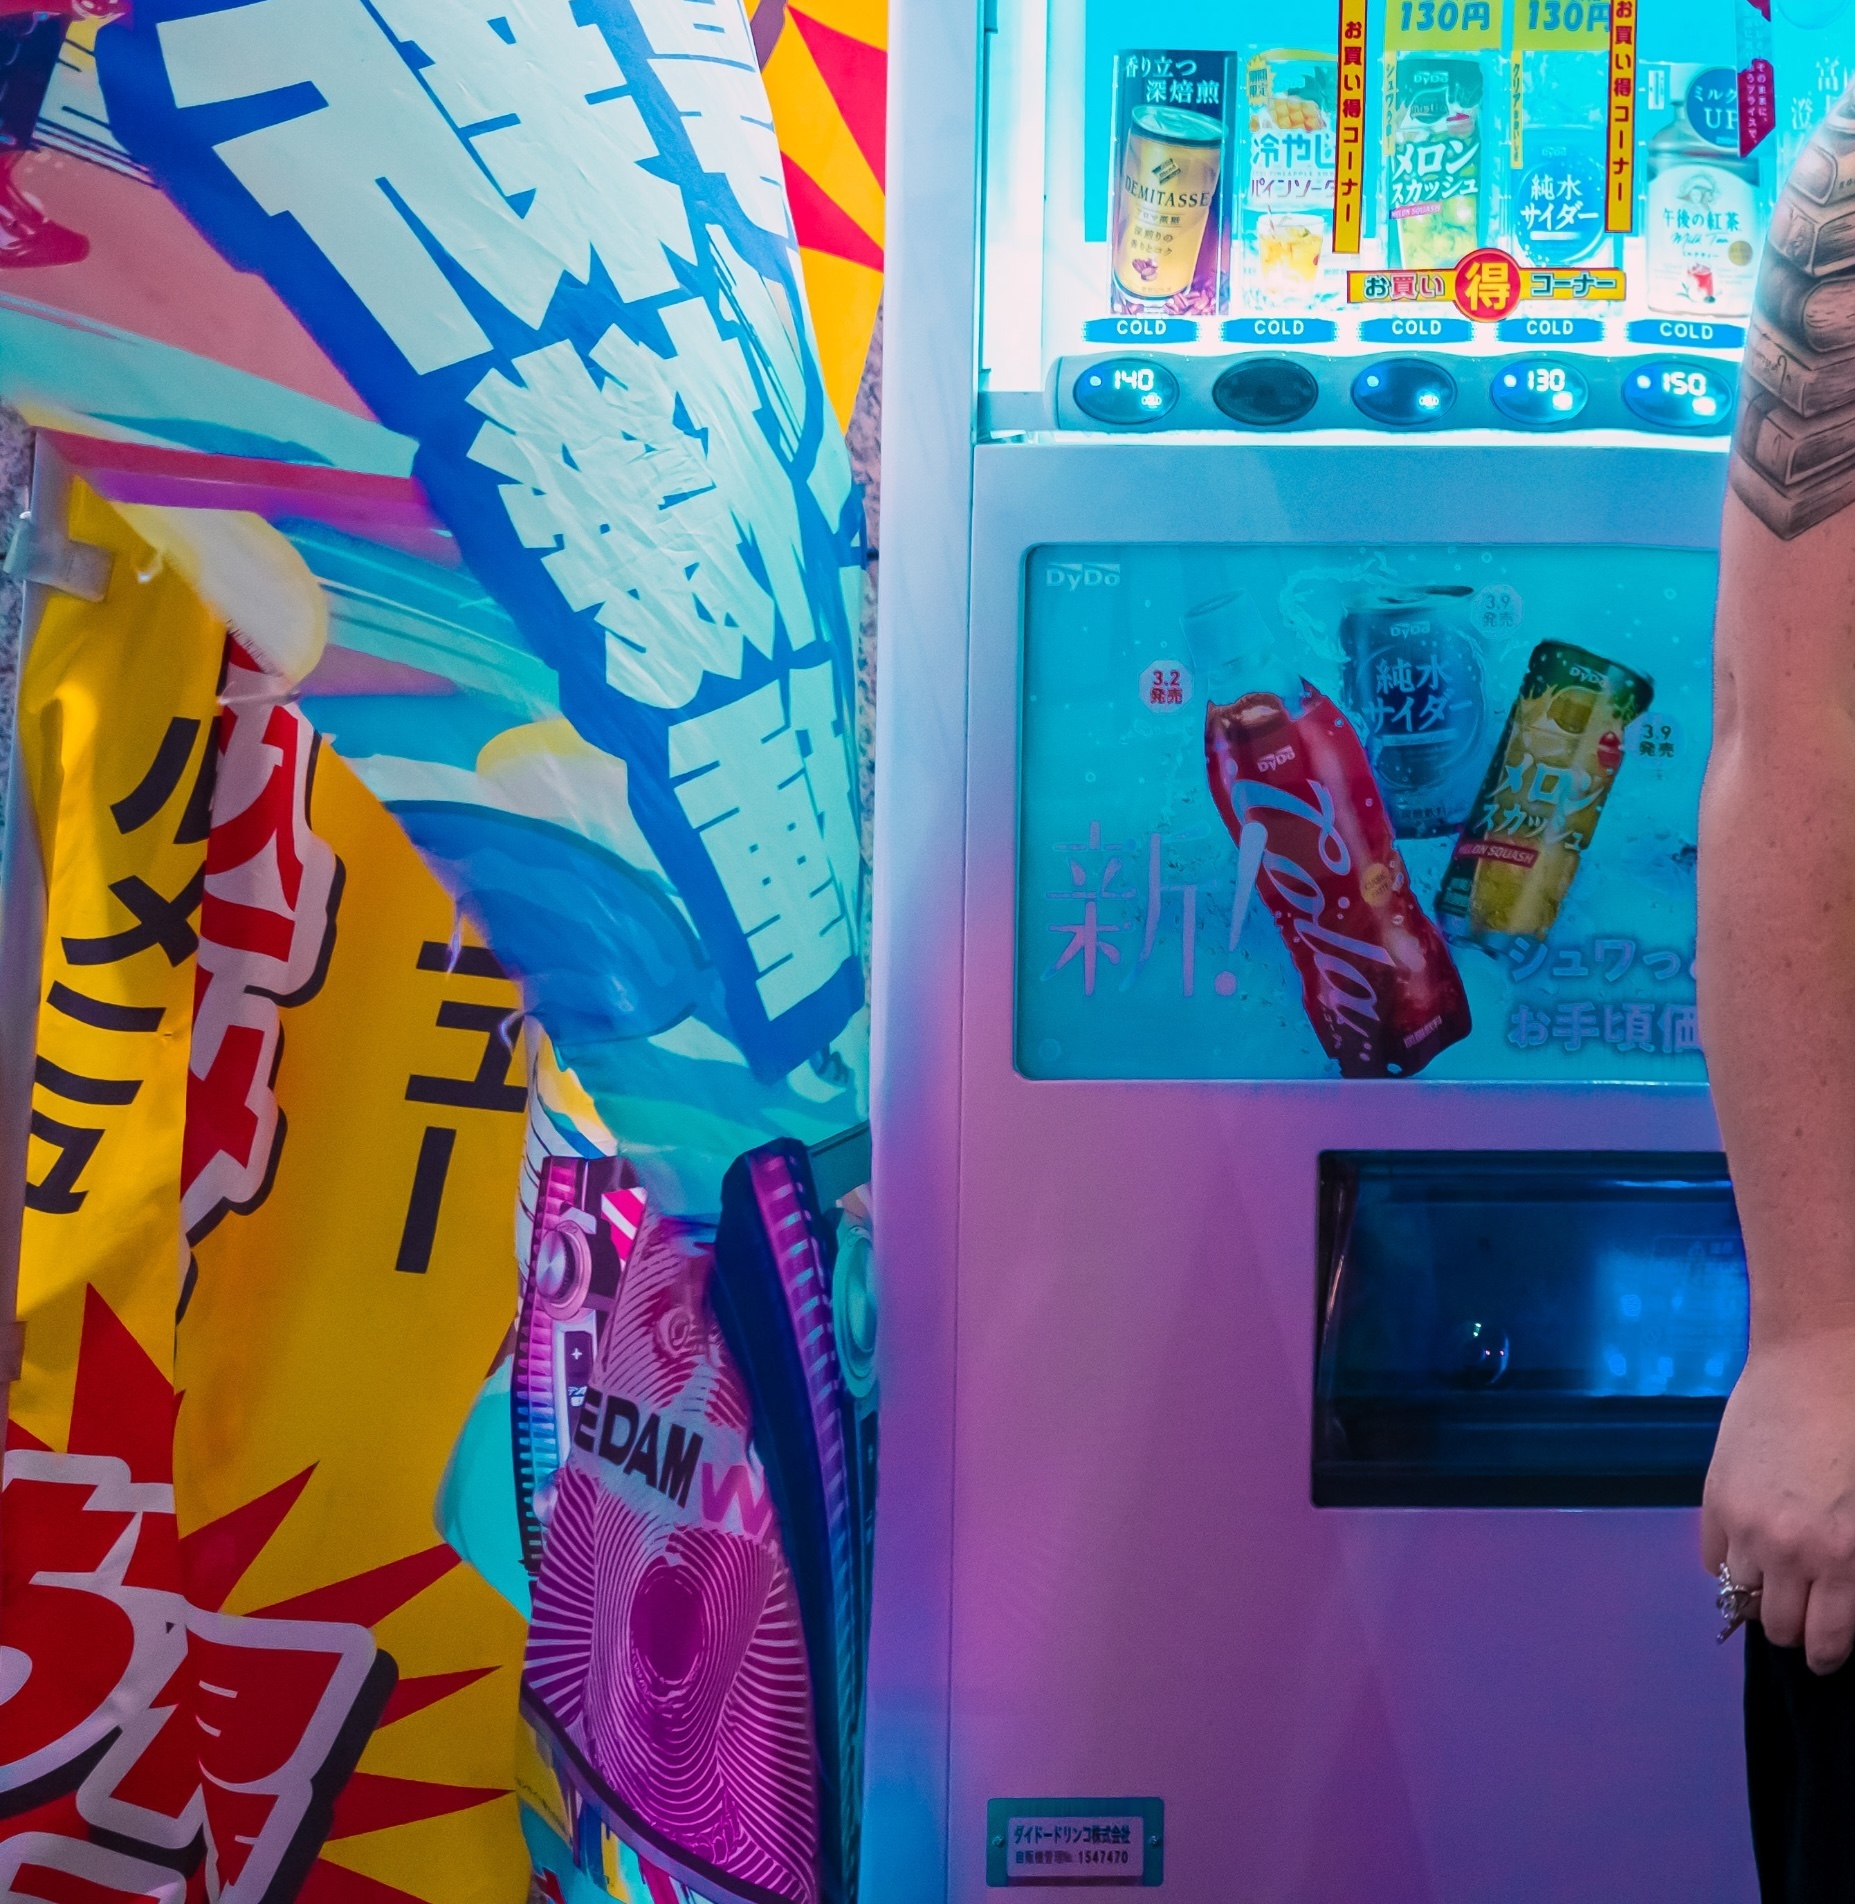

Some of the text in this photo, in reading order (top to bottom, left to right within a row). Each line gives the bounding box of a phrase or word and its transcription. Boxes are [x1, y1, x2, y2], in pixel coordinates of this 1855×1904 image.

[1400, 0, 1491, 33] 130円
[1125, 56, 1198, 79] 香り立つ
[1391, 136, 1481, 181] メロン
[1124, 175, 1211, 210] DEMITASSE
[1530, 172, 1583, 201] 純水
[1520, 198, 1600, 233] サイダー
[1045, 562, 1122, 589] DyDo
[1014, 1824, 1131, 1844] ダイドードリンコ株式会社
[1078, 1850, 1129, 1864] 1547470
